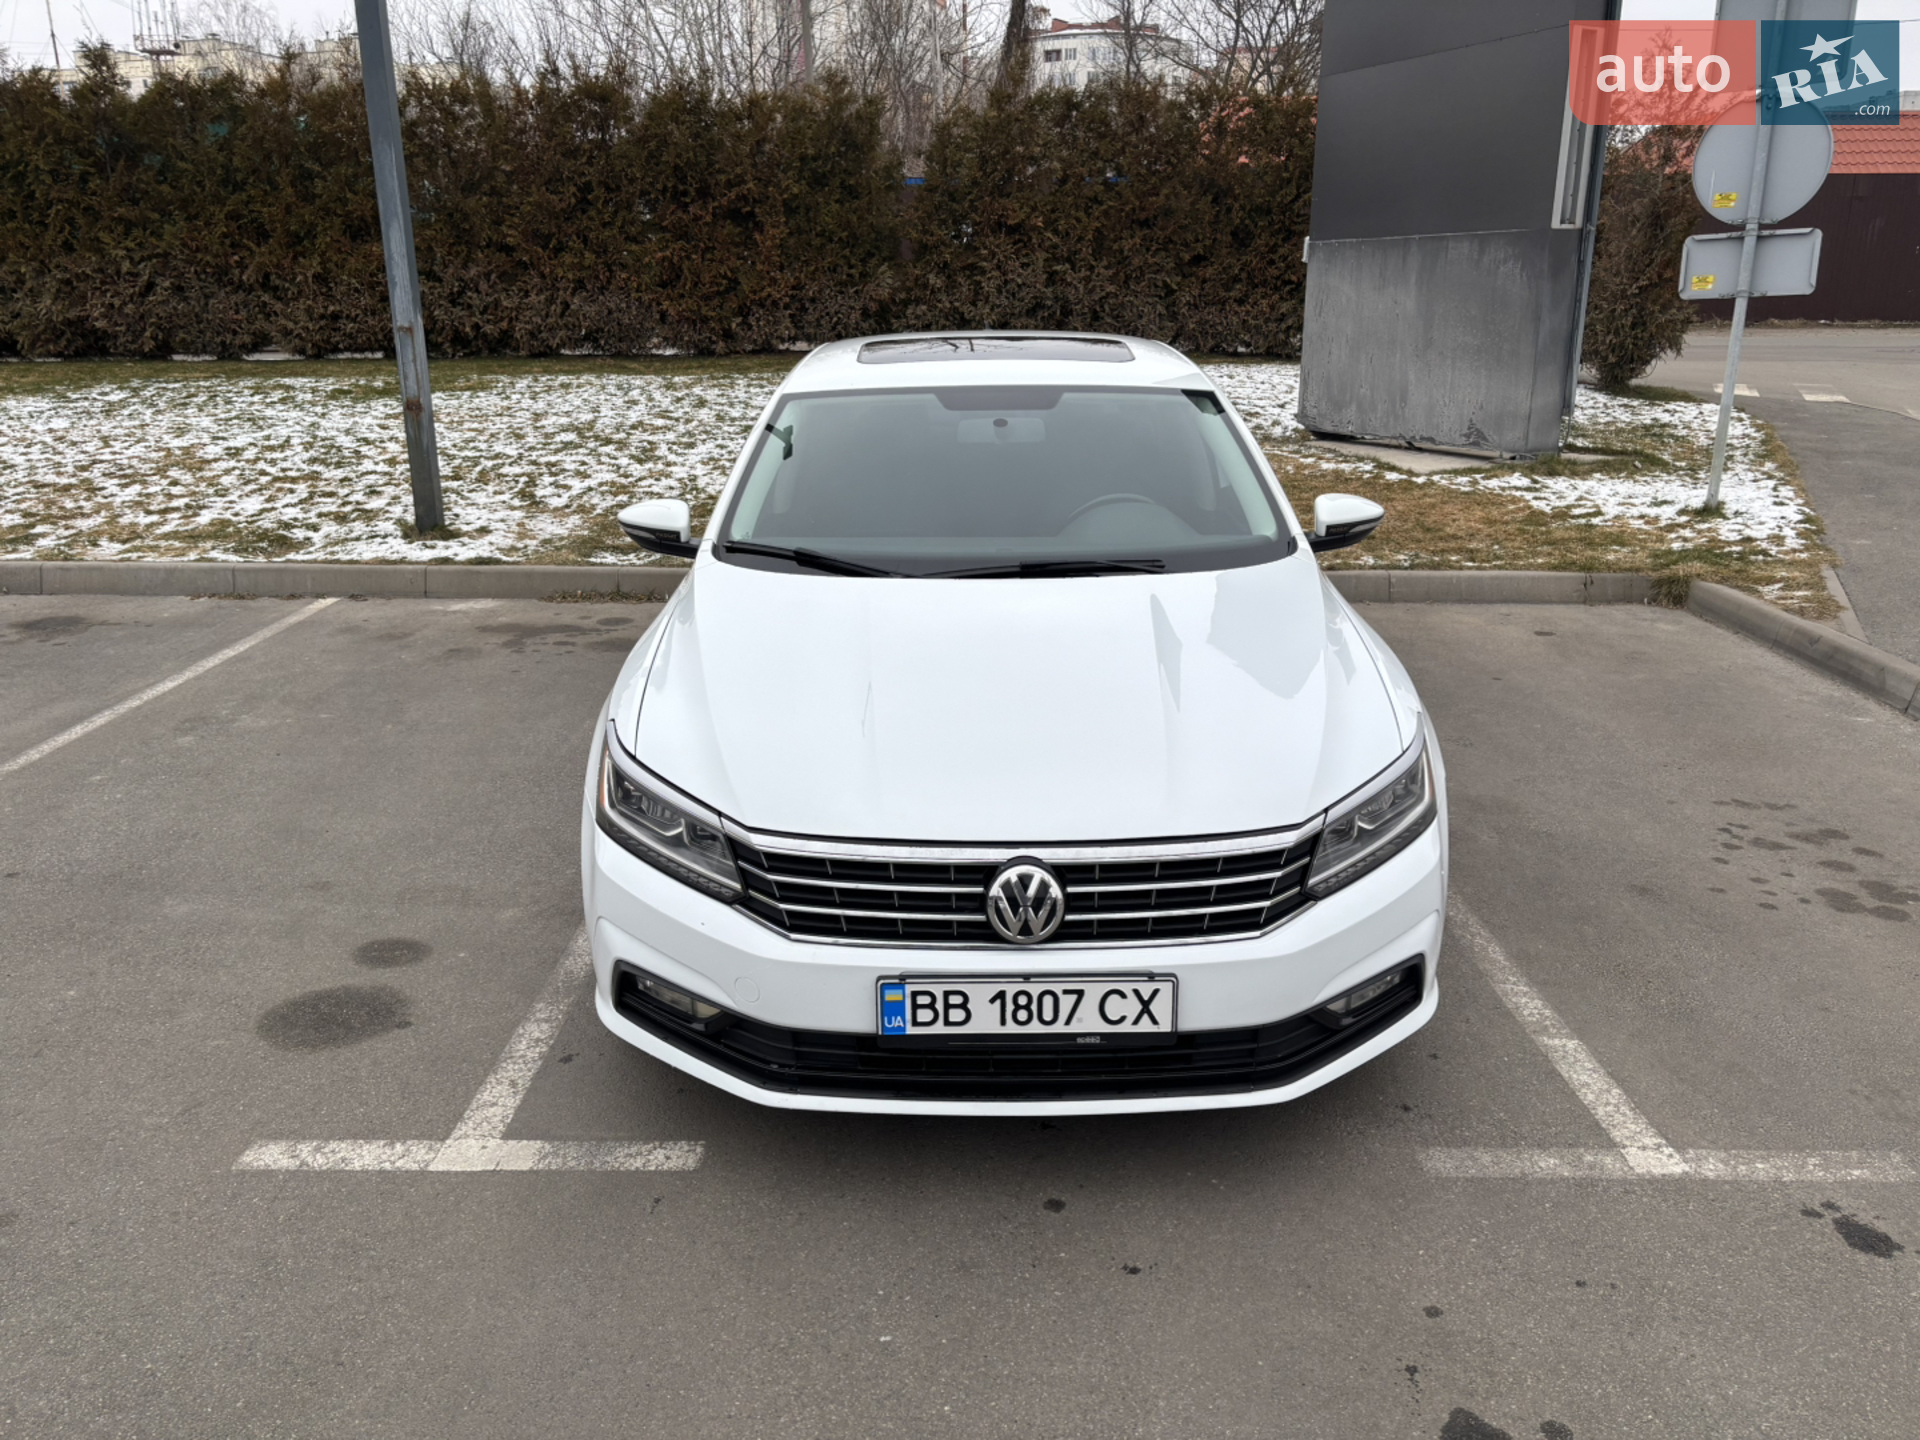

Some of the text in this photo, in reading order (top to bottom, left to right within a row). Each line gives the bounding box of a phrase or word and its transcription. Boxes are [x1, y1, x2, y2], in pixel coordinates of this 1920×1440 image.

[910, 987, 1161, 1027] BB 1807 CX
[884, 1015, 904, 1027] UA
